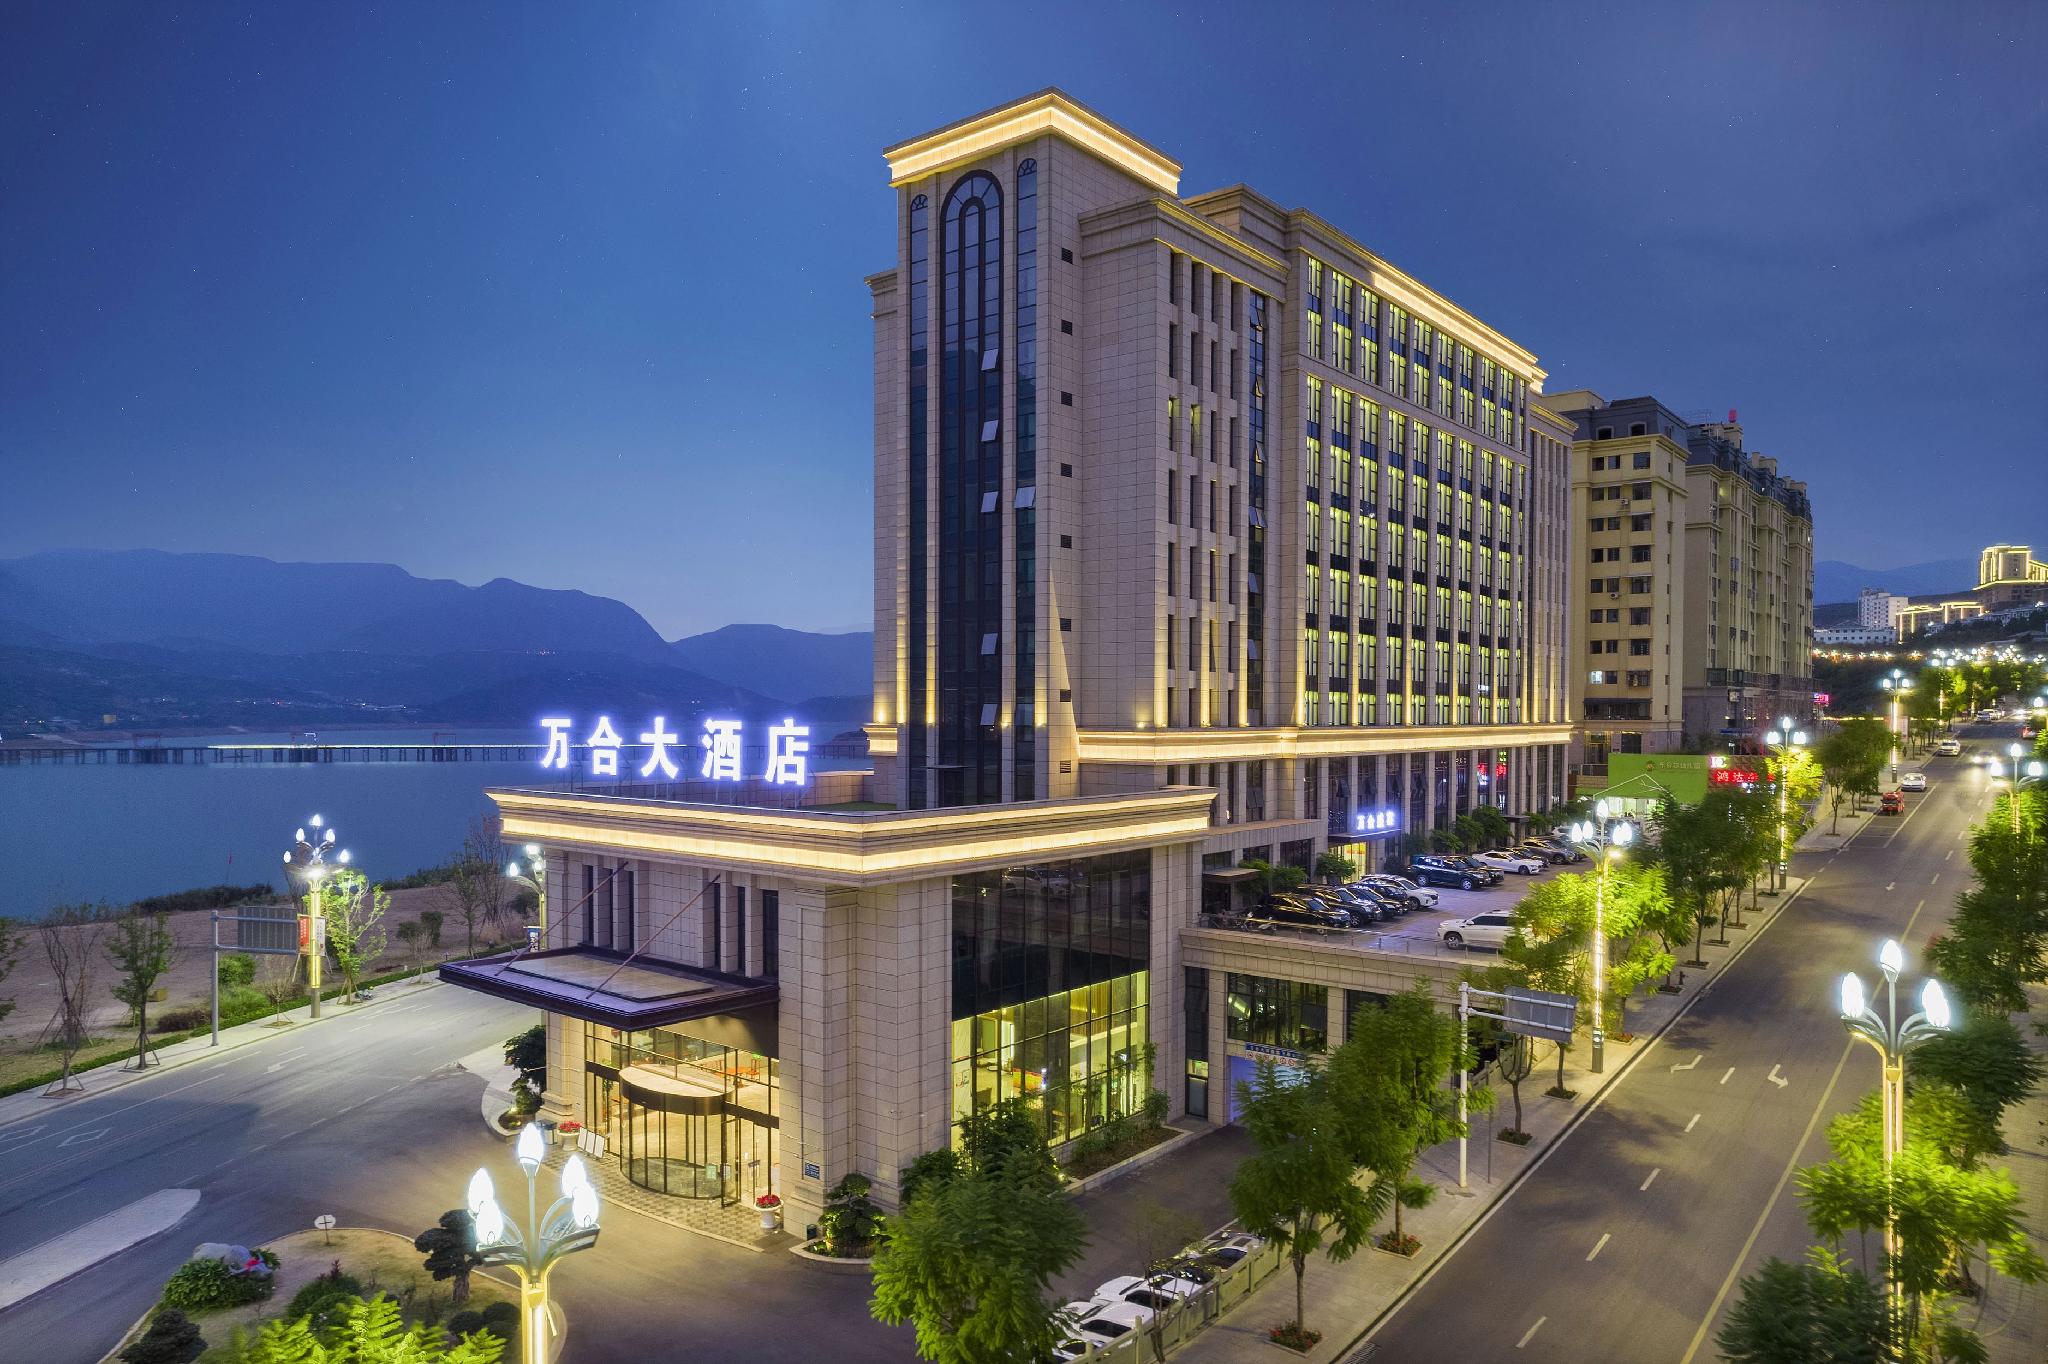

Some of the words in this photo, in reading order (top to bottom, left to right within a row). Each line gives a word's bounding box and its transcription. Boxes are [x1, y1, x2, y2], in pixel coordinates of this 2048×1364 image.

[541, 716, 809, 785] 万合大酒店
